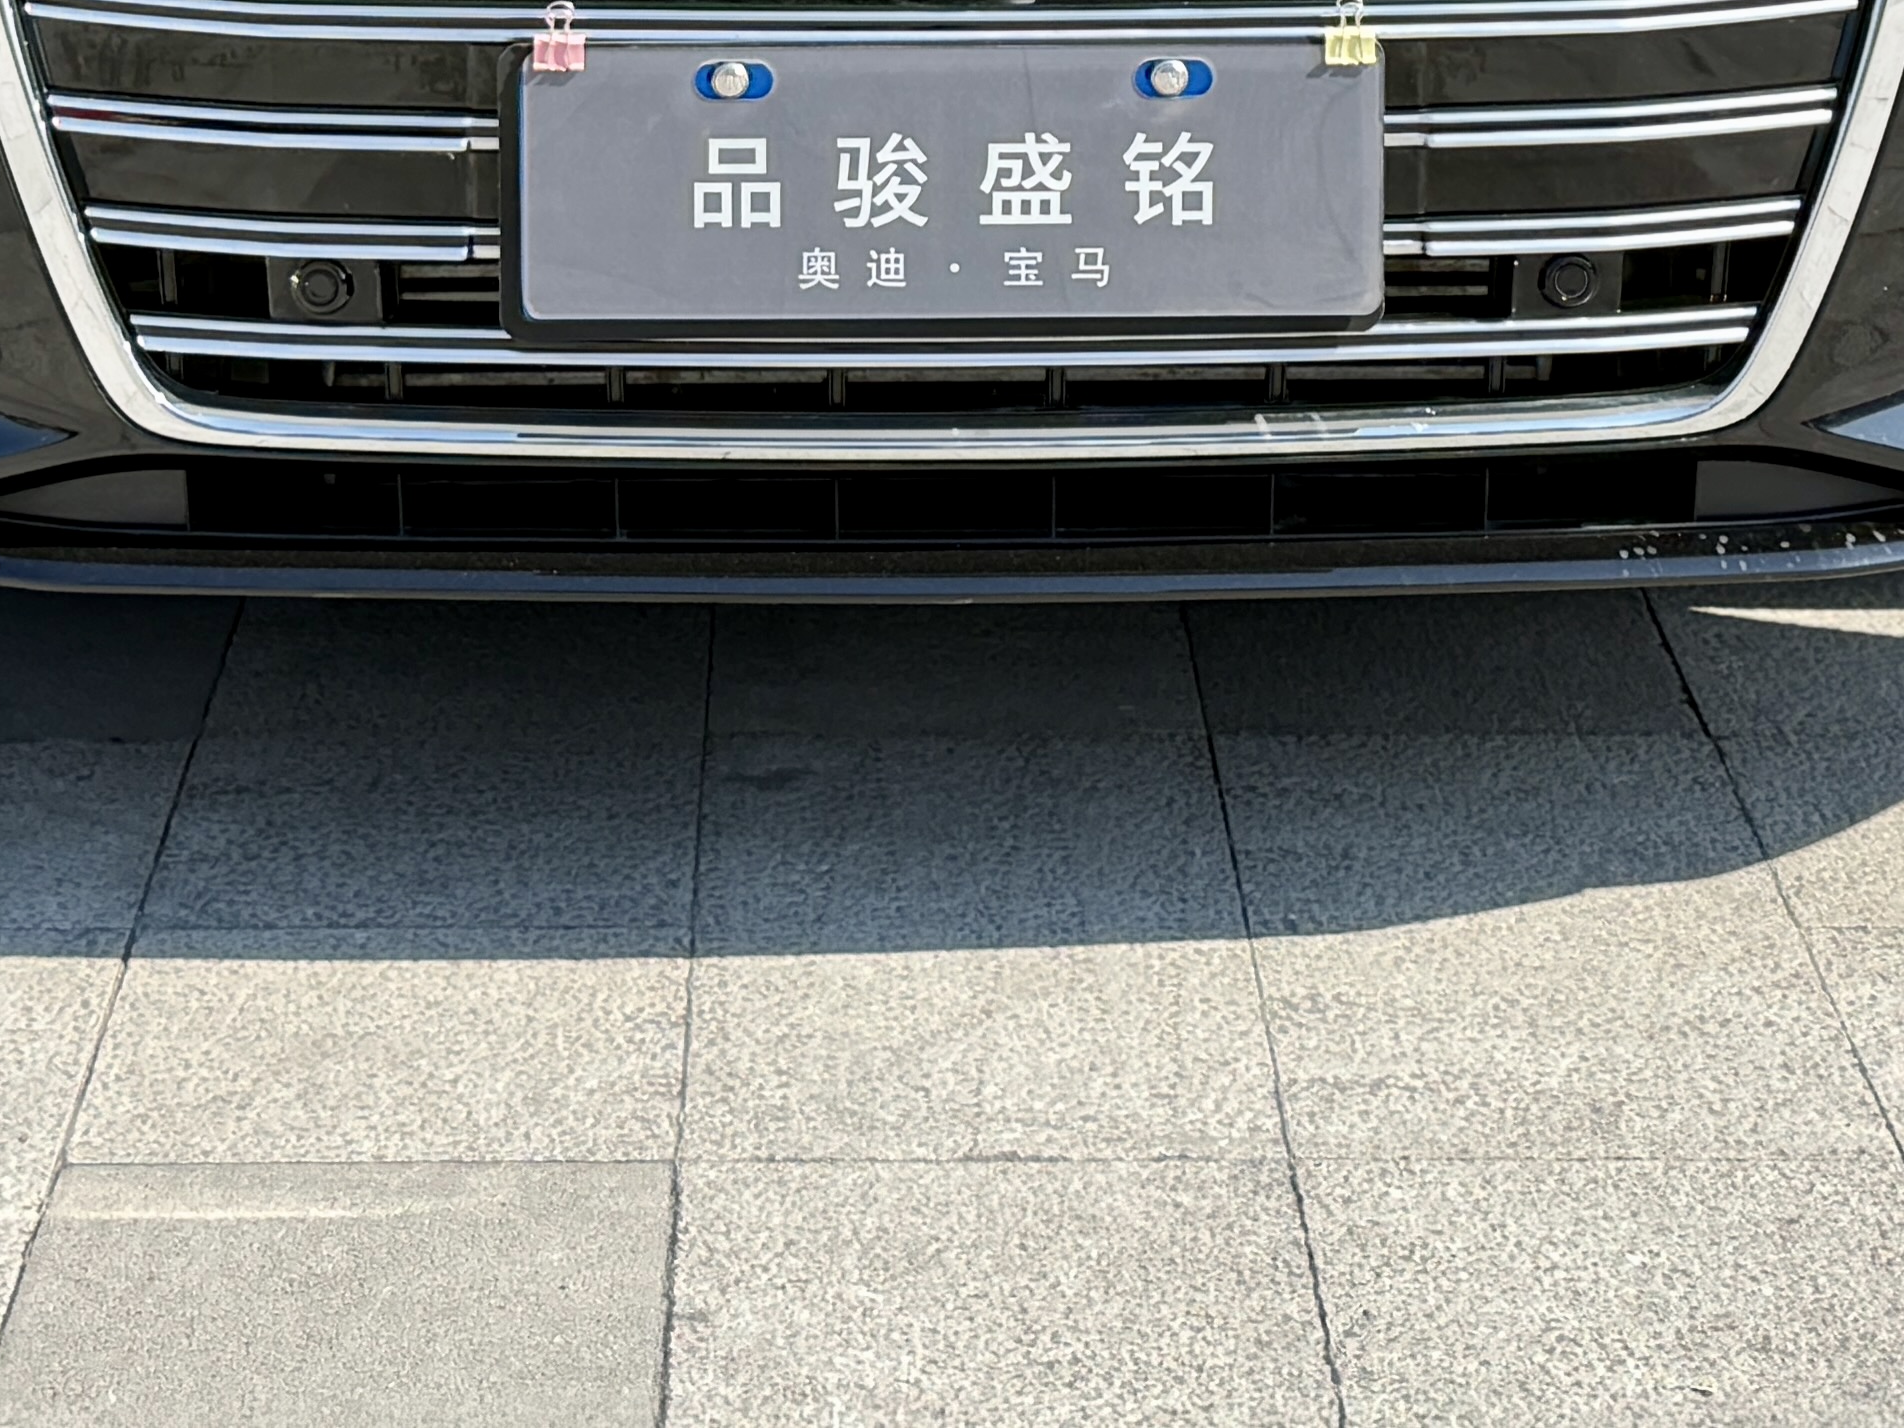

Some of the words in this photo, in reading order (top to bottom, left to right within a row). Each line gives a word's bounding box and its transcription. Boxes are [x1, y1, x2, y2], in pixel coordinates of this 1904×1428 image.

[692, 132, 1217, 228] 品骏盛铭
[797, 247, 1113, 290] 奥迪·宝马
